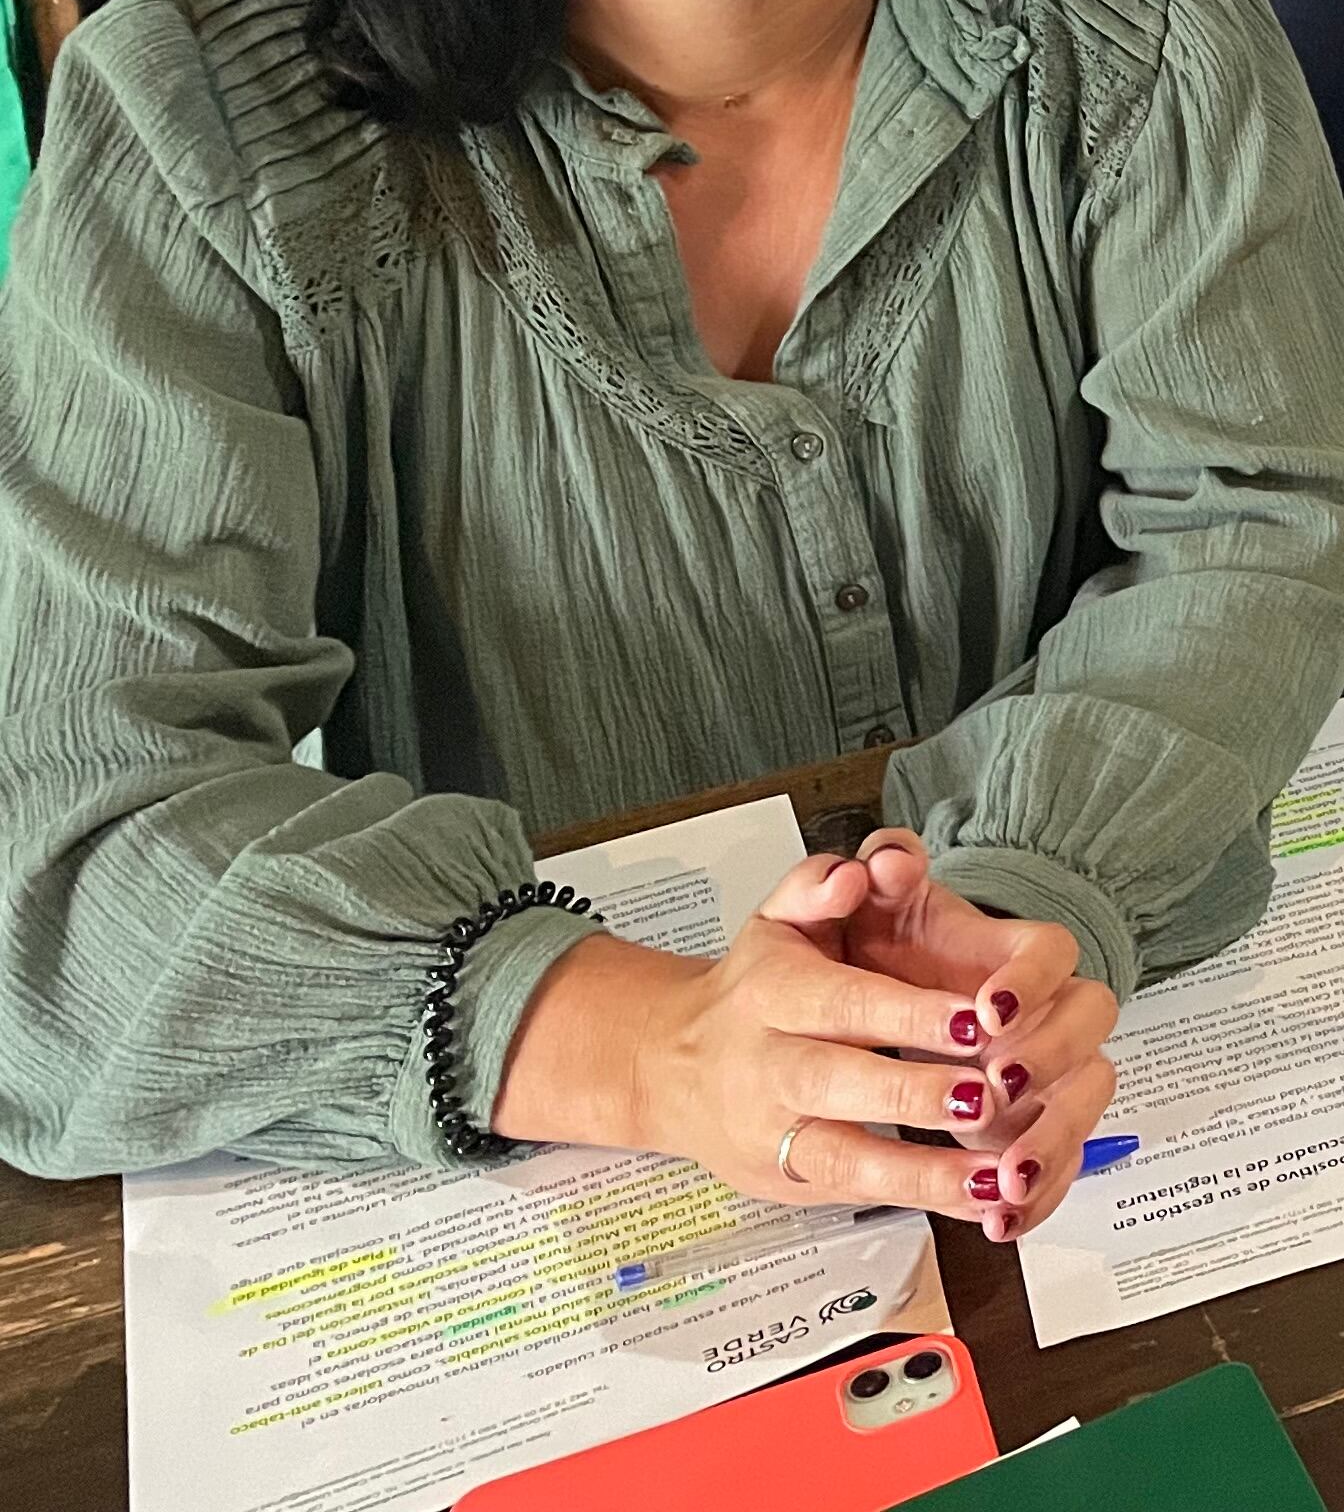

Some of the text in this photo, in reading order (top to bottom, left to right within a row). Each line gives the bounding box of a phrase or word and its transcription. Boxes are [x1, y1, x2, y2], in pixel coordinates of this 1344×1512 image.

[1222, 1166, 1241, 1178] la
[1245, 1158, 1269, 1172] de
[581, 1180, 602, 1192] las
[604, 1170, 632, 1184] con
[1246, 1178, 1270, 1191] de
[516, 1187, 579, 1212] medidas
[1115, 1173, 1218, 1210] legislatura
[1219, 1186, 1241, 1200] su
[485, 1208, 514, 1222] que
[1142, 1191, 1214, 1222] gestión
[418, 1216, 482, 1243] propone
[1112, 1216, 1137, 1230] en
[351, 1248, 384, 1264] Plan
[400, 1239, 416, 1252] el
[327, 1260, 348, 1272] de
[690, 1270, 704, 1281] la
[259, 1267, 325, 1297] Igualdad
[307, 1208, 761, 1367] los Premios Mujeres Infinitas, el concurso de vídeos contra el
[311, 1209, 720, 1348] las jornadas de formación sobre violencia de género, la
[232, 1290, 256, 1305] del
[605, 1275, 687, 1310] promoción
[551, 1294, 591, 1316] salud
[583, 1305, 603, 1317] de
[493, 1309, 547, 1336] mental
[522, 1266, 826, 1379] para dar vida a este espacio de cuidados.
[523, 1312, 580, 1337] hábitos
[300, 1245, 818, 1429] En materia de Salud se han desarrollado iniciativas innovadoras en el
[447, 1328, 490, 1348] tanto
[702, 1314, 807, 1361] VERDE
[409, 1341, 444, 1360] para
[433, 1332, 520, 1366] saludables,
[706, 1325, 809, 1373] CASTRO
[332, 1356, 406, 1386] escolares
[386, 1362, 431, 1383] como
[284, 1381, 330, 1402] como
[324, 1378, 383, 1404] talleres
[244, 1395, 281, 1415] para
[229, 1399, 321, 1435] anti-tabaco
